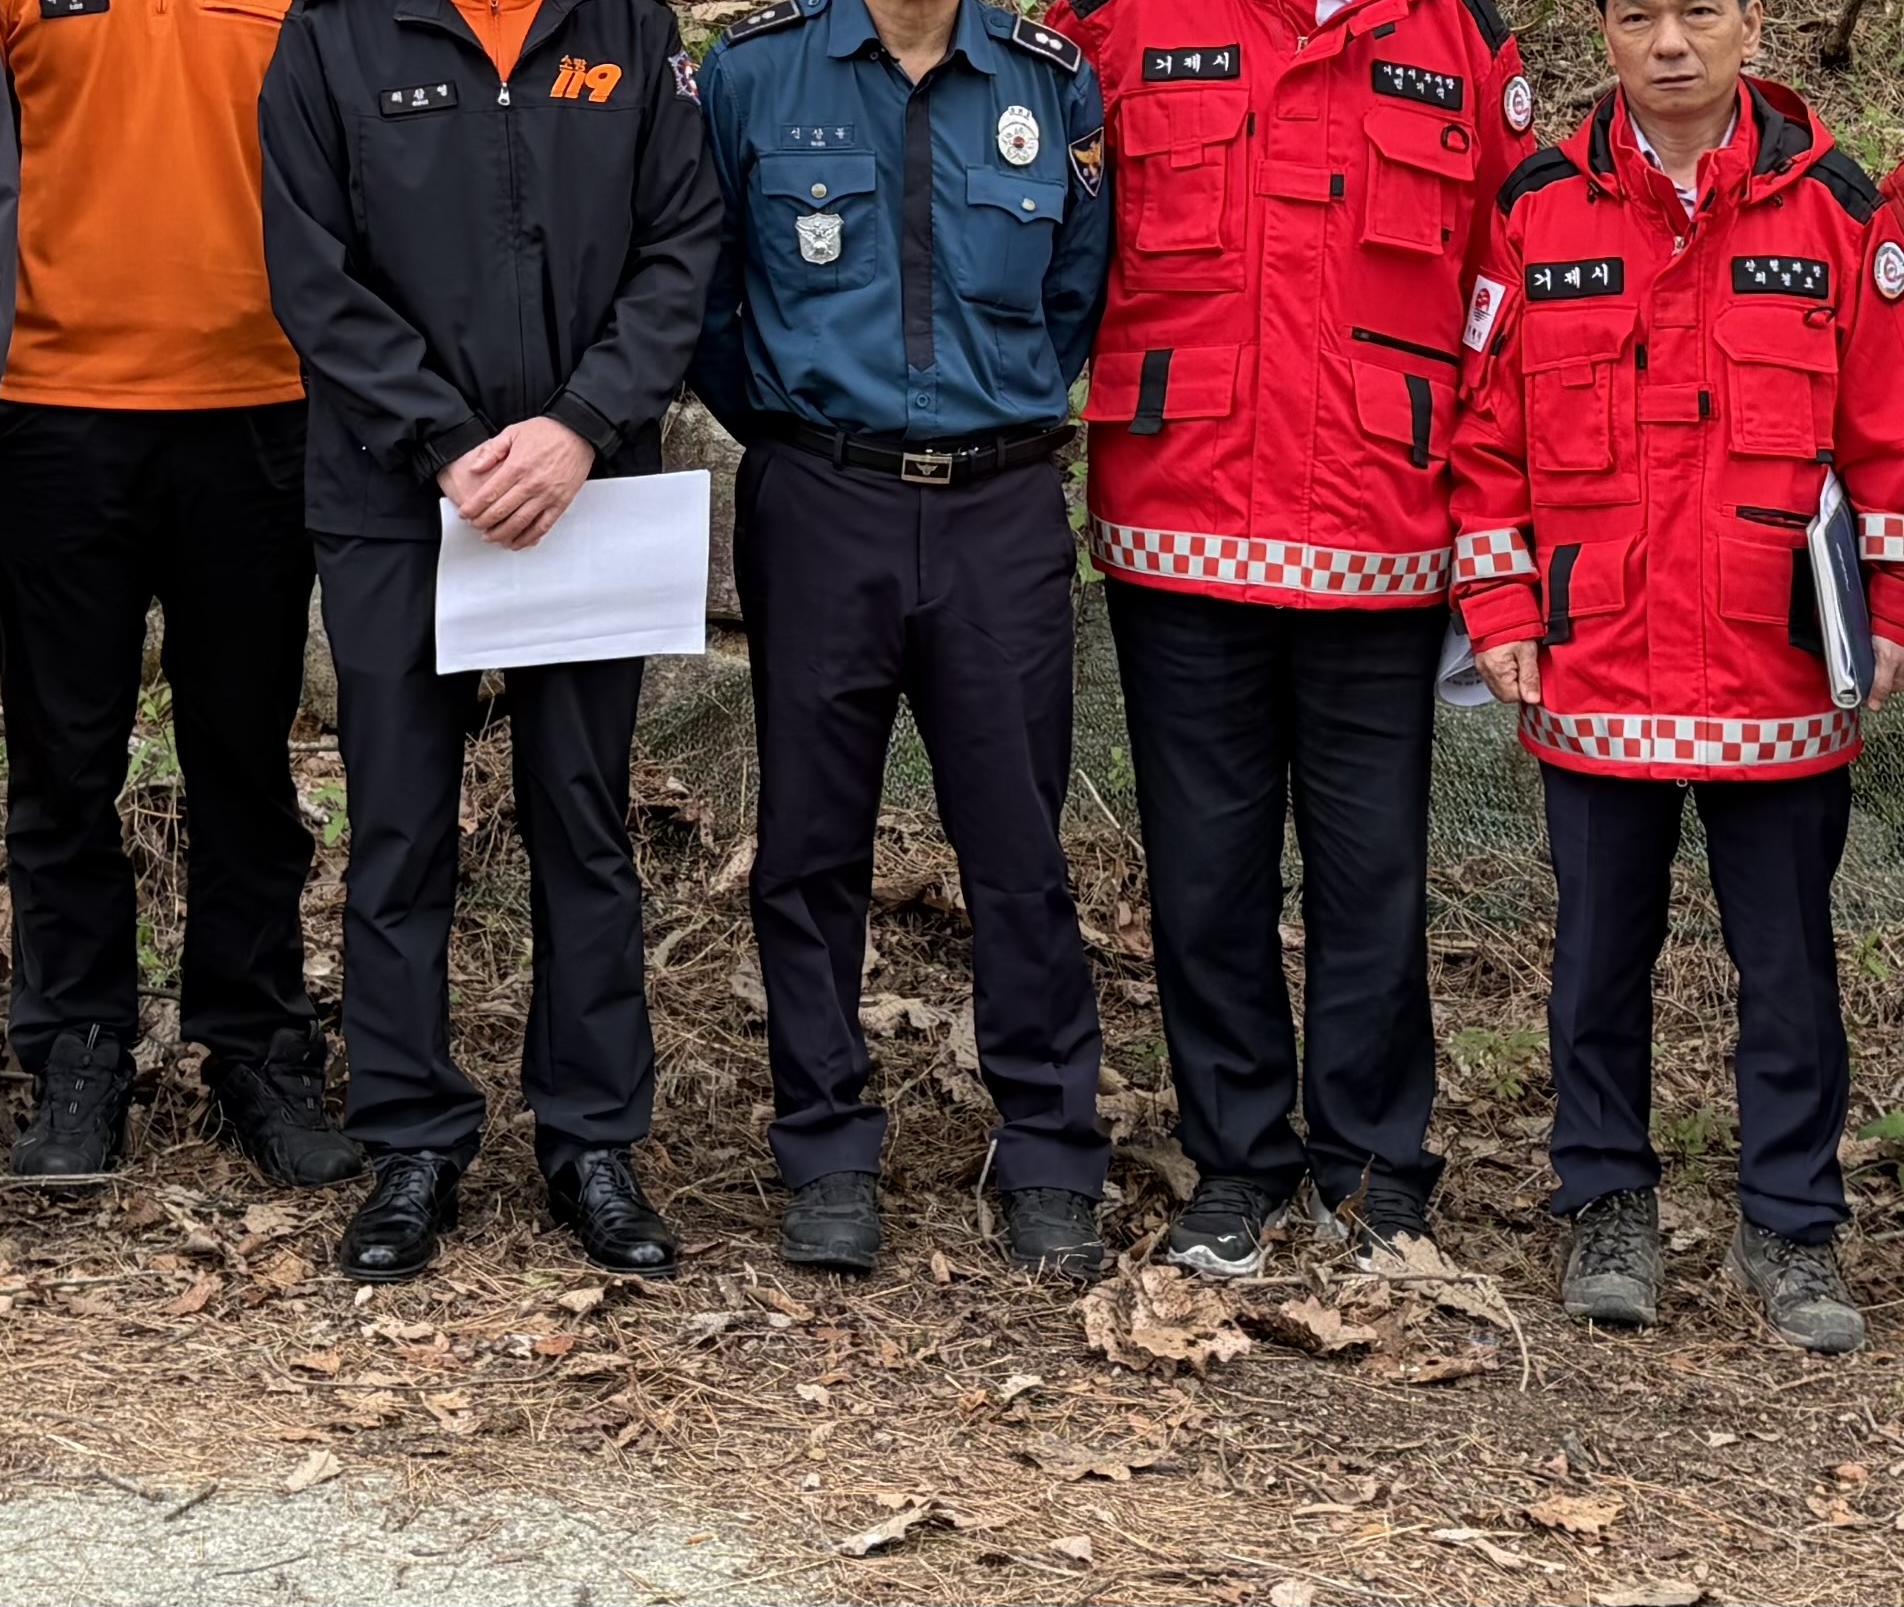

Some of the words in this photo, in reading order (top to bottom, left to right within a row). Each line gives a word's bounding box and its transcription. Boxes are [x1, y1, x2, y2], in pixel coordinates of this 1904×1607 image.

[1155, 52, 1230, 75] 거제시
[549, 63, 622, 103] 119
[1534, 263, 1609, 291] 거제시
